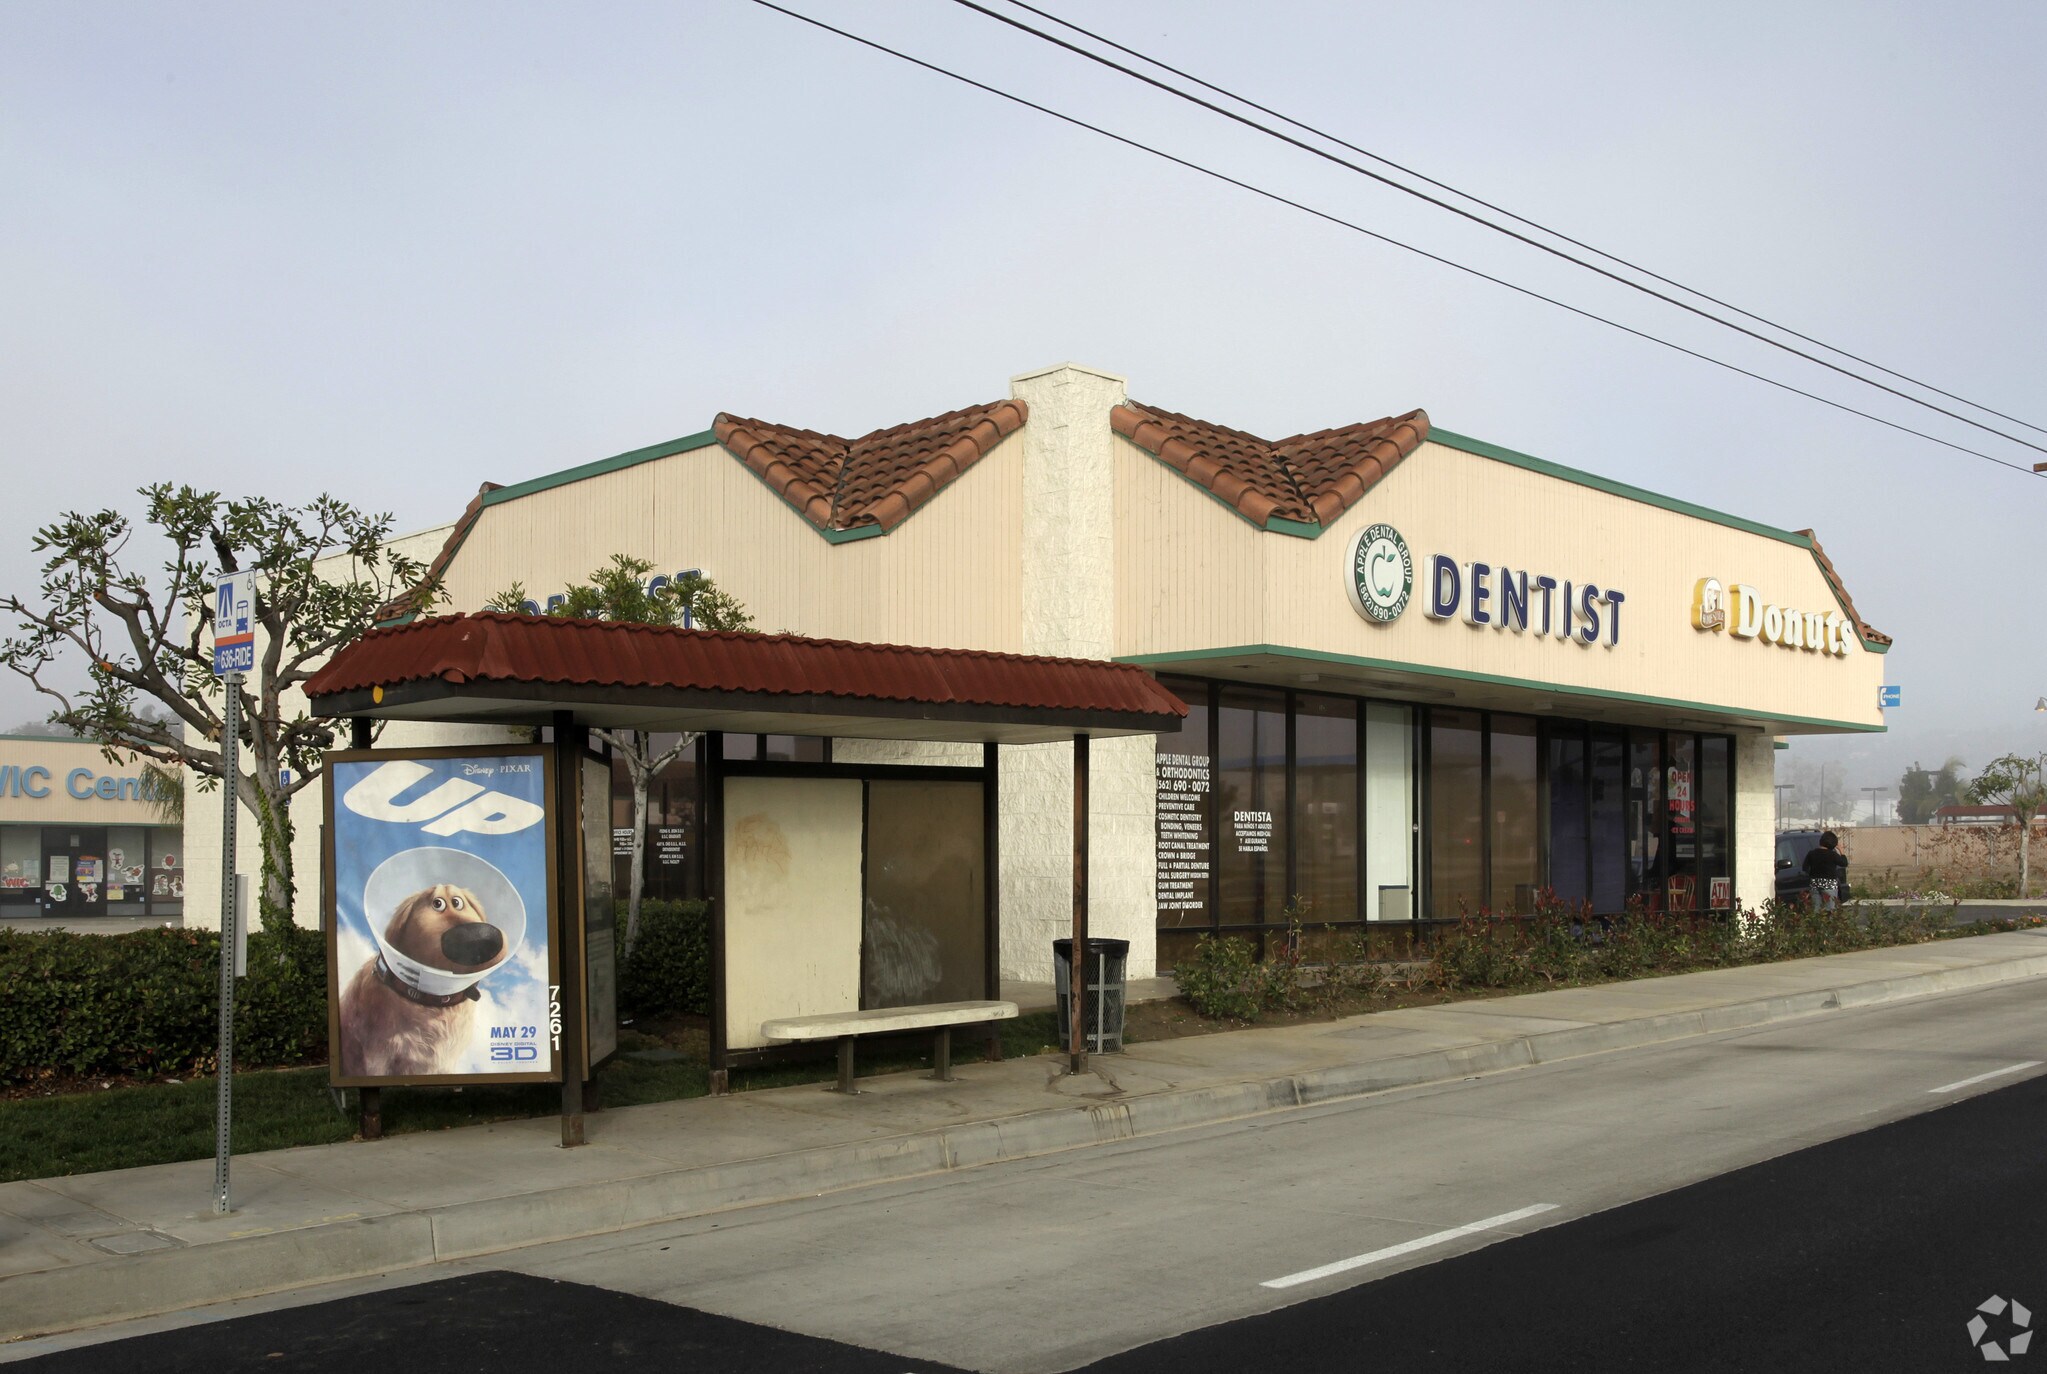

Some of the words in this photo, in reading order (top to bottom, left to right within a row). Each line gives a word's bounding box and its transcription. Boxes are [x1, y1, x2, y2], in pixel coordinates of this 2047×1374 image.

[1357, 536, 1371, 574] APPLE
[1370, 526, 1398, 544] DENTAL
[1398, 542, 1412, 584] GROUP
[1360, 582, 1374, 610] (562)
[1430, 553, 1625, 646] DENTIST
[218, 620, 232, 628] OCTA
[1738, 584, 1853, 655] Donuts
[221, 646, 252, 669] 636-RIDE
[1156, 753, 1171, 764] APPLE
[1172, 754, 1191, 766] DENTAL
[1192, 755, 1210, 767] GROUP
[461, 764, 494, 778] Disney
[500, 764, 532, 773] PIXAR
[1162, 767, 1210, 780] ORTHODONTICS
[1672, 771, 1692, 783] OPEN
[1156, 779, 1171, 790] (562)
[1174, 780, 1187, 791] 690
[1192, 781, 1210, 792] 0072
[1677, 786, 1687, 797] 24
[344, 760, 544, 837] UP
[1669, 800, 1695, 812] HOURS
[1234, 811, 1272, 822] DENTISTA
[1712, 883, 1729, 898] ATM
[549, 986, 562, 1051] 7261
[491, 1026, 517, 1038] MAY
[521, 1026, 536, 1038] 29
[491, 1047, 537, 1060] 3D
